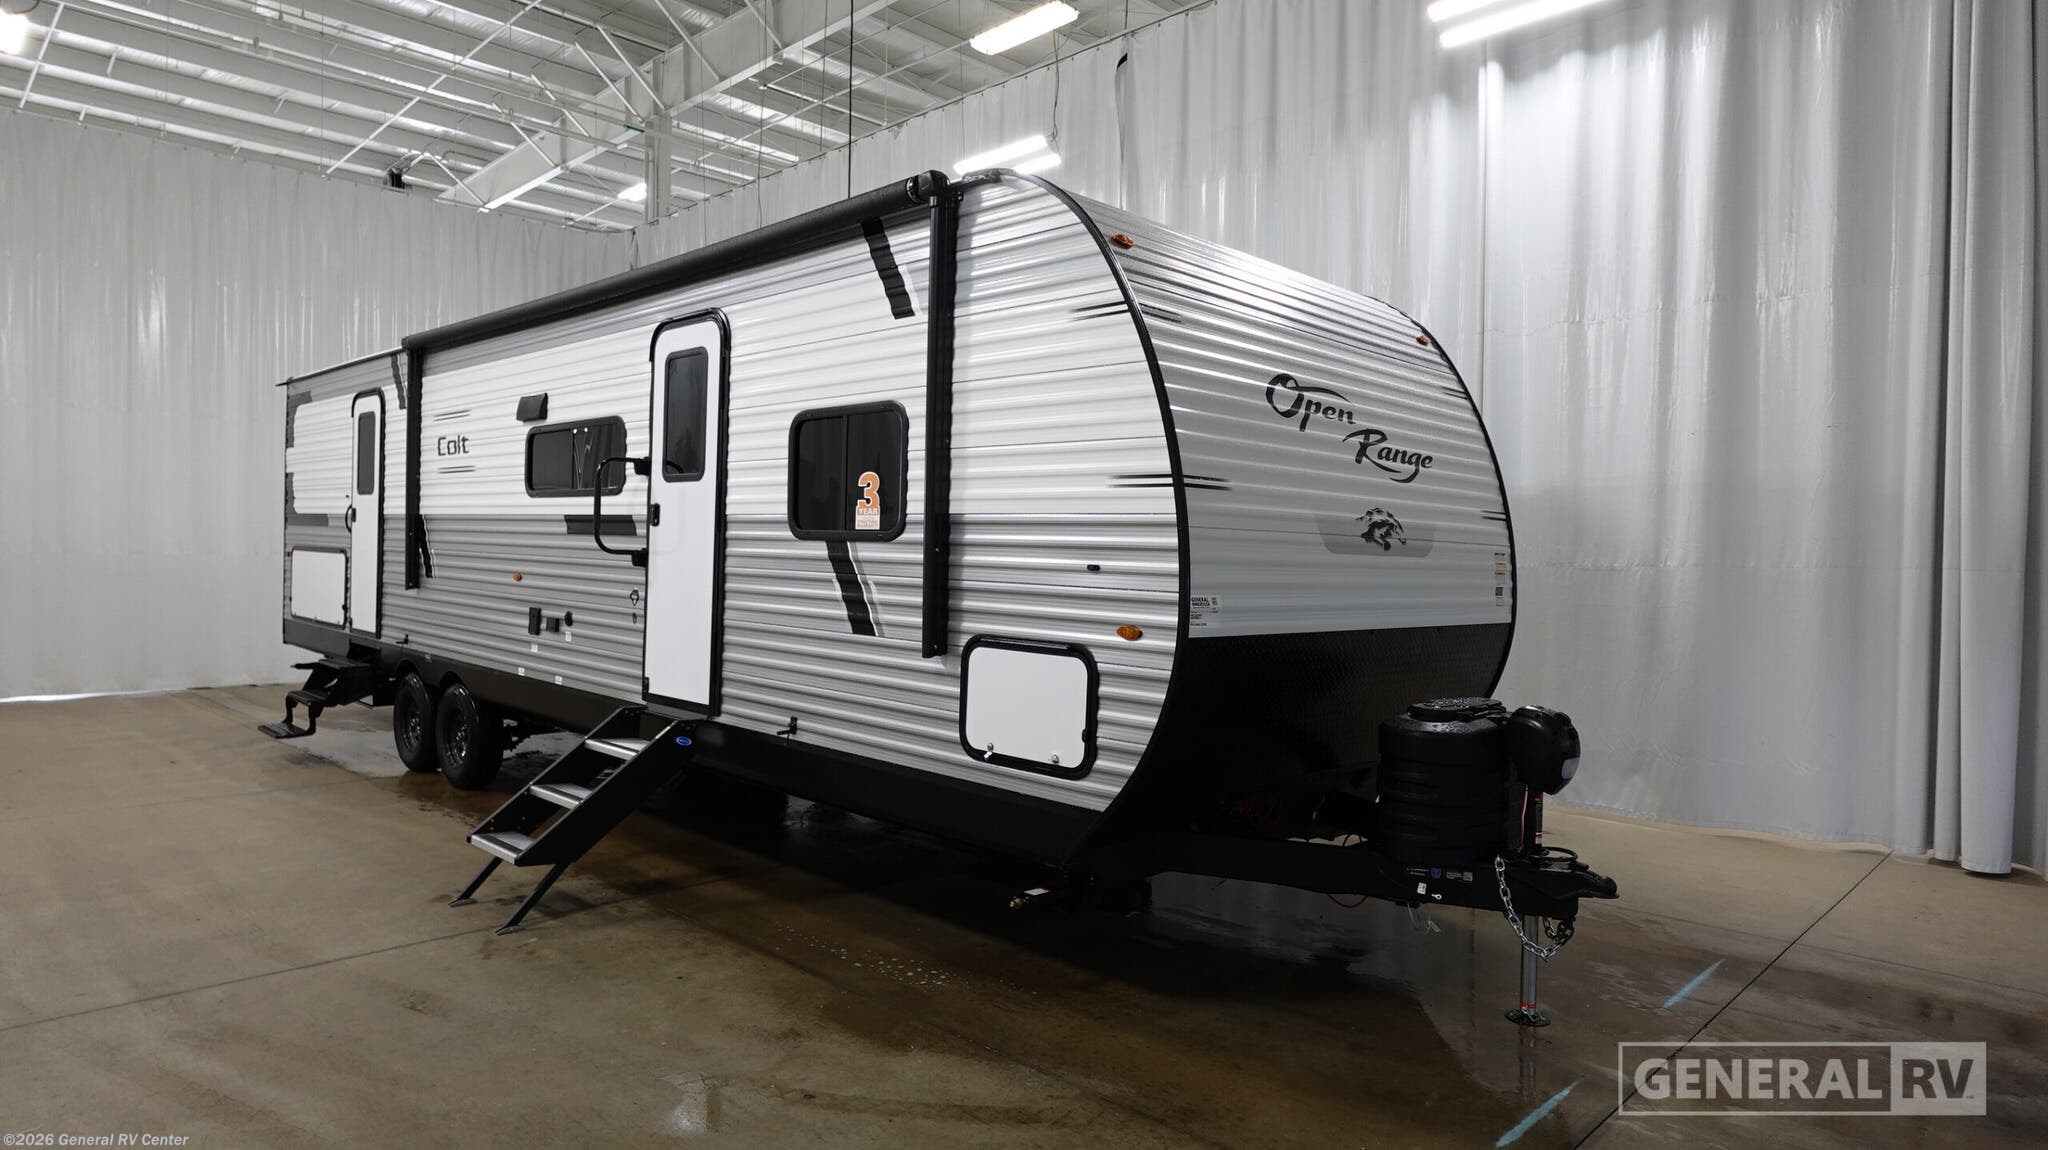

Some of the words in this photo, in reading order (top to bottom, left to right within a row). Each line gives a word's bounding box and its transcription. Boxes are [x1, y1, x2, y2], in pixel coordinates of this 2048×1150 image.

[1266, 373, 1356, 432] Open
[437, 434, 470, 456] Colt
[1342, 428, 1433, 483] Range
[857, 471, 880, 508] 3
